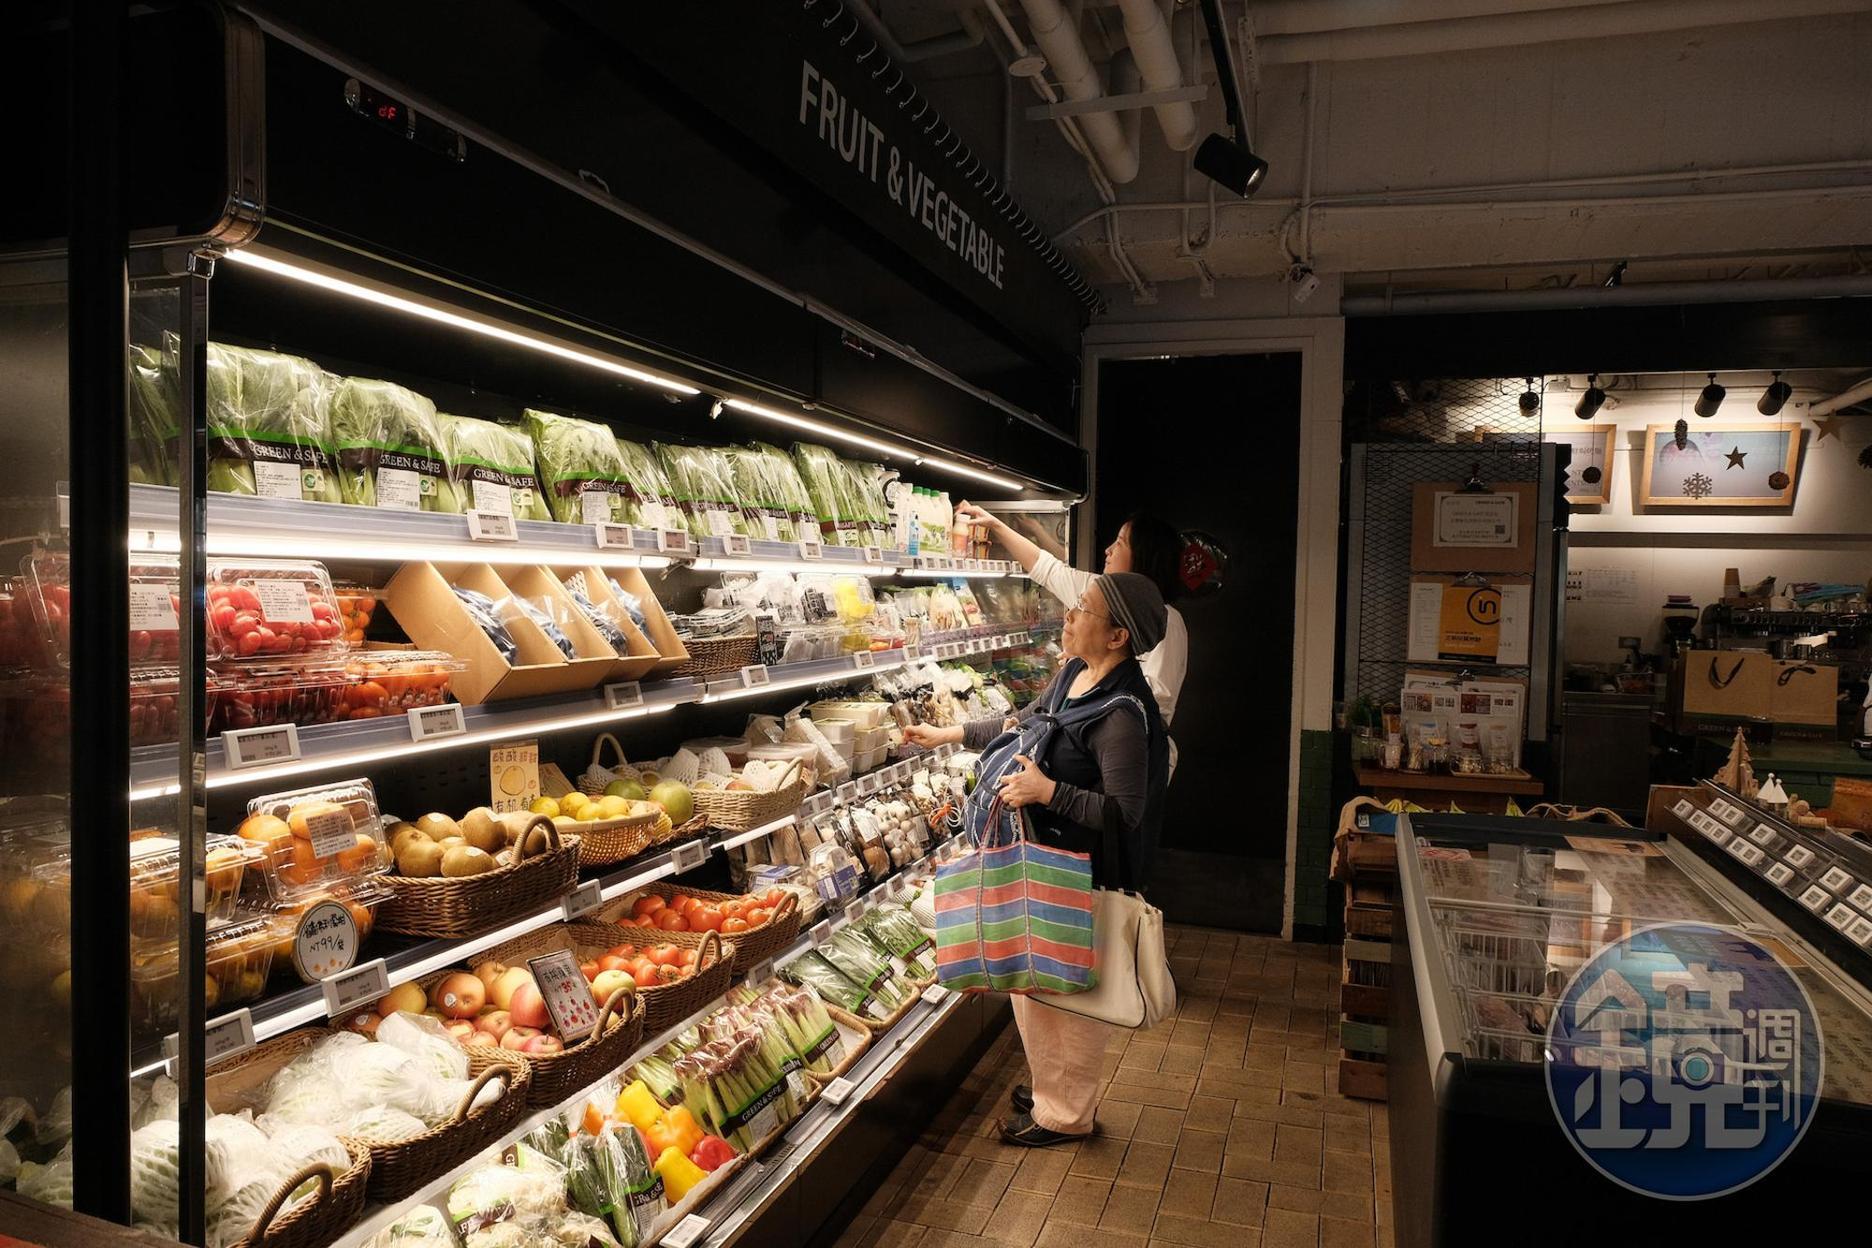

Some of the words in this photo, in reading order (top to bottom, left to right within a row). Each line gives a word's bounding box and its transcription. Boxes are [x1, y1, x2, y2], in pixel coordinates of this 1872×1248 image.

[799, 60, 884, 183] FRUIT
[887, 145, 903, 206] &
[908, 162, 1005, 290] VEGETABLE
[253, 443, 292, 460] GREEN
[293, 449, 303, 461] &
[379, 454, 411, 468] GREEN
[412, 459, 420, 470] &
[420, 460, 441, 474] SAFE
[473, 468, 503, 482] GREEN
[510, 476, 534, 487] SAFE
